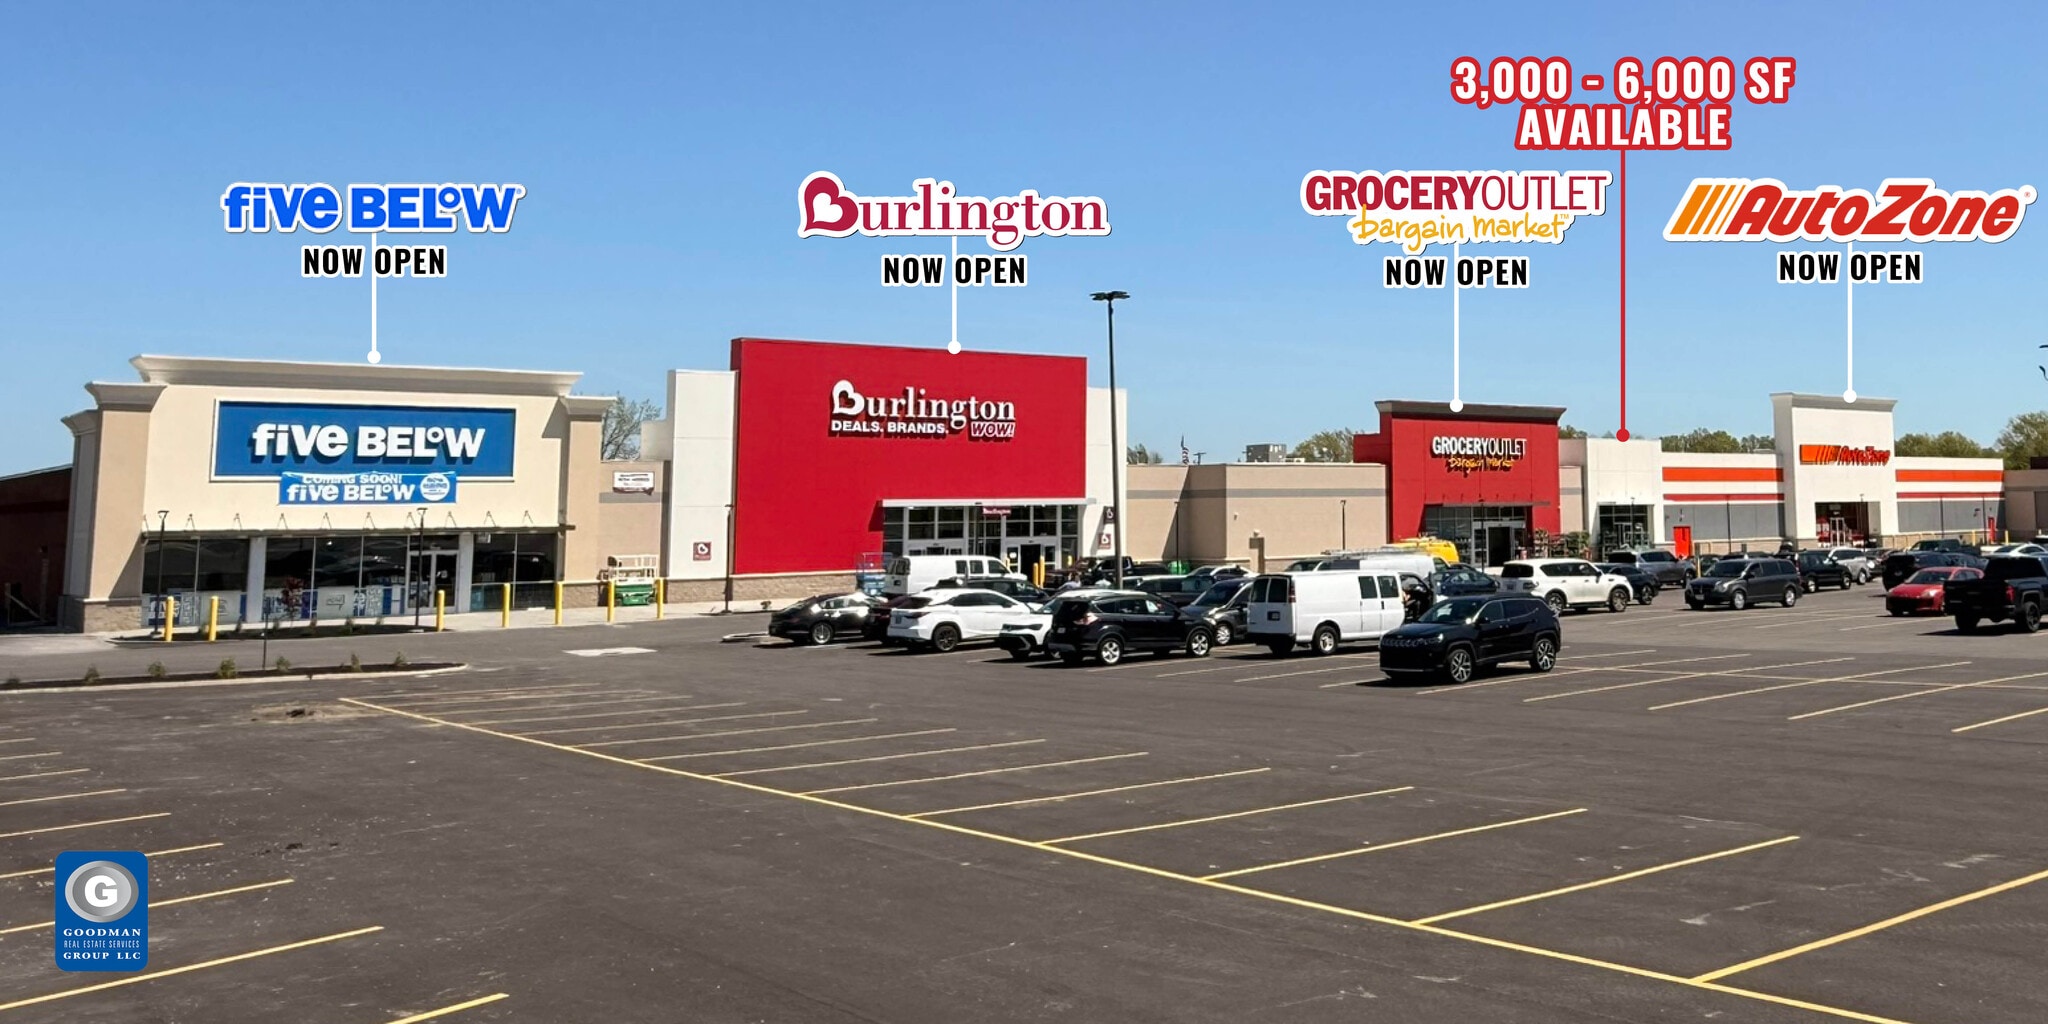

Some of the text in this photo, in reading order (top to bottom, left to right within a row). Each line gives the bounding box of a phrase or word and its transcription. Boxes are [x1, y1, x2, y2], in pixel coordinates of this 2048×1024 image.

[832, 380, 1016, 430] Burlington
[831, 420, 1016, 438] DEALS. BRANDS. WOW!
[252, 423, 486, 458] five BELOW
[1432, 436, 1527, 456] GROCERYOUTLET
[286, 484, 415, 501] five BELOW
